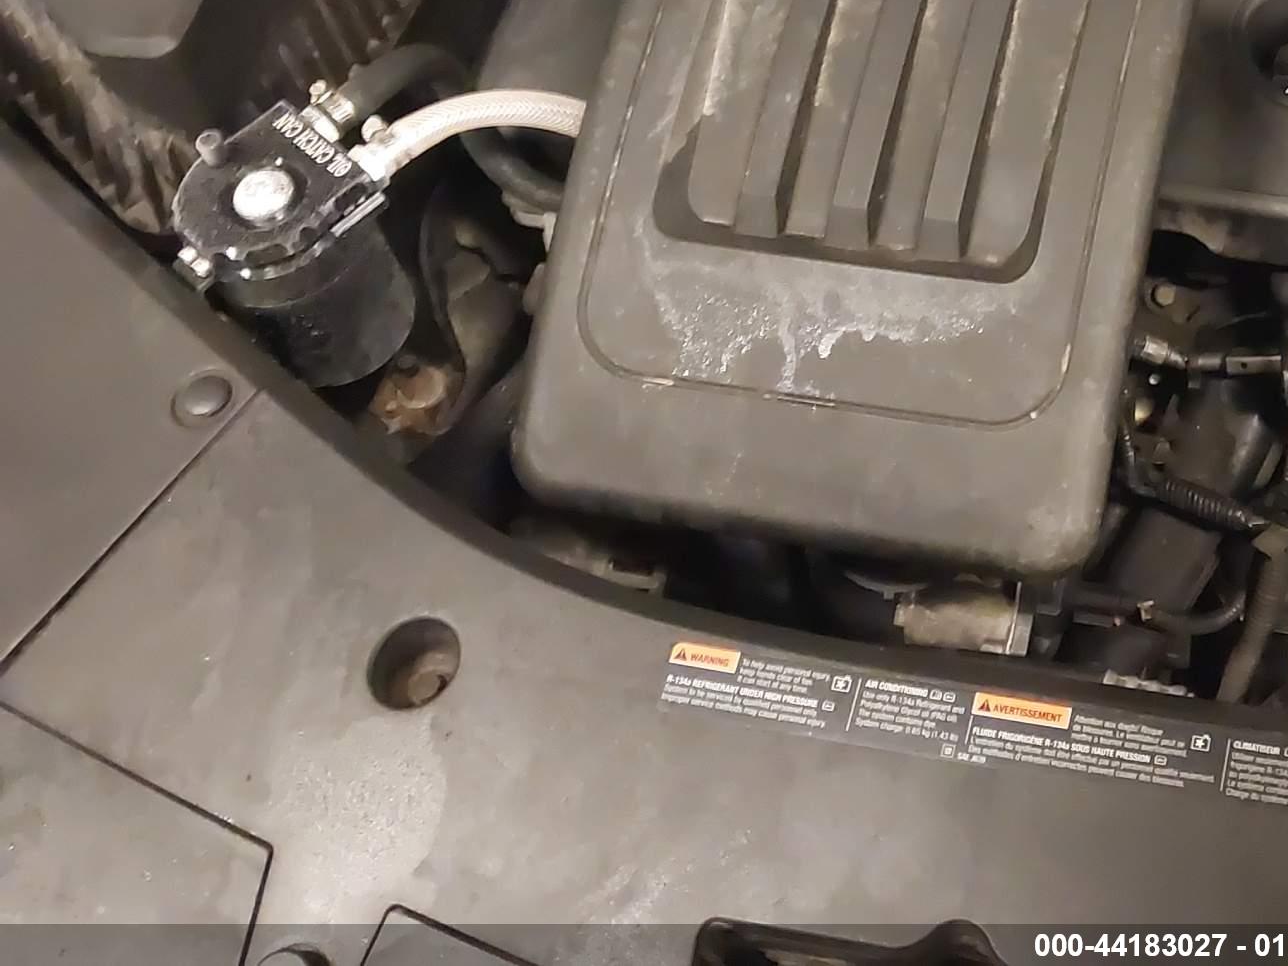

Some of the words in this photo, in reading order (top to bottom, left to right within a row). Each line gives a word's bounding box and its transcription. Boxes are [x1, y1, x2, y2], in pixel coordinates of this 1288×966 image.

[272, 112, 303, 139] CAN
[292, 129, 335, 165] CATCH
[326, 153, 353, 178] OIL
[689, 653, 730, 666] WARNING
[691, 680, 739, 694] REFRIGERANT
[739, 687, 764, 698] UNDER
[763, 691, 782, 701] HIGH
[781, 694, 819, 707] PRESSURE
[864, 680, 878, 689] AIR
[878, 682, 928, 697] CONDITIONING
[992, 704, 1062, 722] AVERTISSEMENT
[1090, 747, 1114, 757] HAUTE
[1115, 750, 1151, 763] PRESSION
[1232, 741, 1280, 755] CLIMATISEUR
